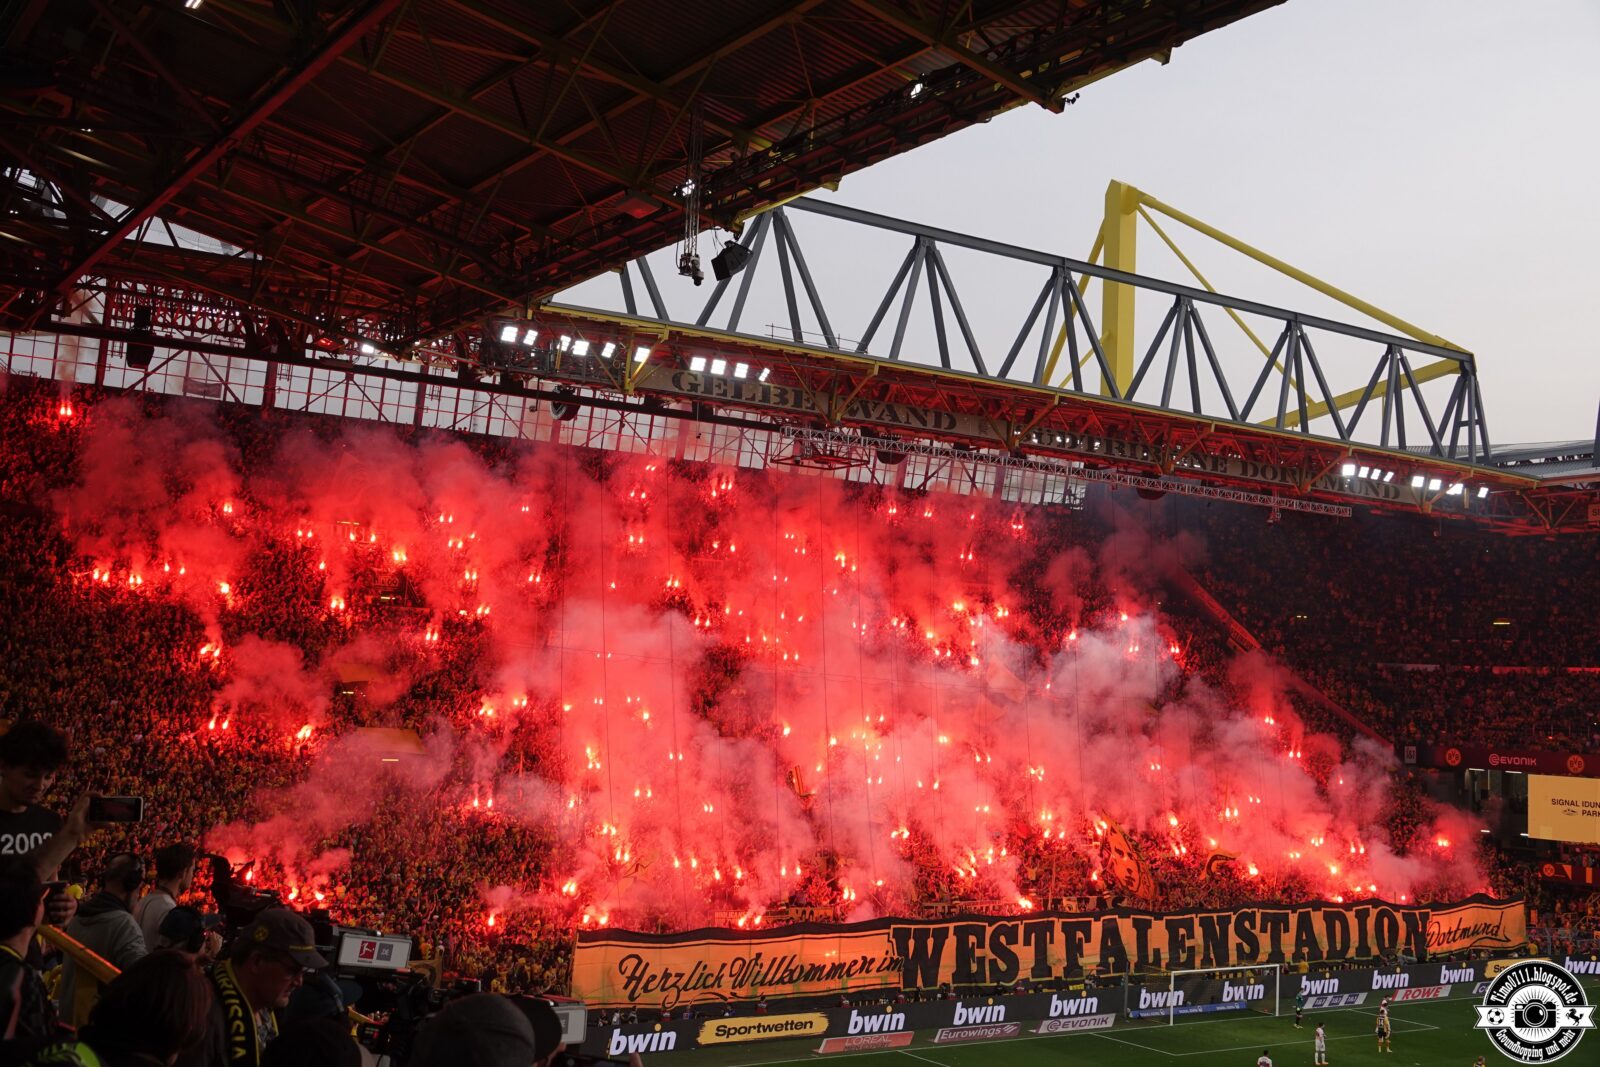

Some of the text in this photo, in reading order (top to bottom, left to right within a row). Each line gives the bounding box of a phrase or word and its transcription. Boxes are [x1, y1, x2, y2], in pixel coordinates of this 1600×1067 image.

[671, 371, 817, 412] GELBE
[843, 396, 957, 431] WAND
[1015, 424, 1229, 474] SÜDTRIBNE
[1551, 798, 1580, 808] SIGNAL
[0, 831, 53, 856] 200
[618, 953, 725, 1010] Herzlich
[728, 952, 876, 988] Willkommen
[876, 950, 904, 974] im
[891, 904, 1432, 991] WESTFALENSTADION
[1425, 911, 1506, 949] Dortmund
[1301, 972, 1340, 997] bwin
[1372, 967, 1411, 990] bwin
[1440, 961, 1476, 985] bwin
[1139, 984, 1185, 1009] bwin
[1222, 978, 1265, 1003] bwin
[1402, 986, 1442, 1001] ROWE
[953, 998, 1006, 1027] bwin
[1050, 990, 1099, 1018] bwin
[715, 1018, 814, 1039] Sportwetten
[847, 1005, 906, 1035] bwin
[609, 1023, 677, 1057] bwin
[940, 1025, 1002, 1042] Eurowings
